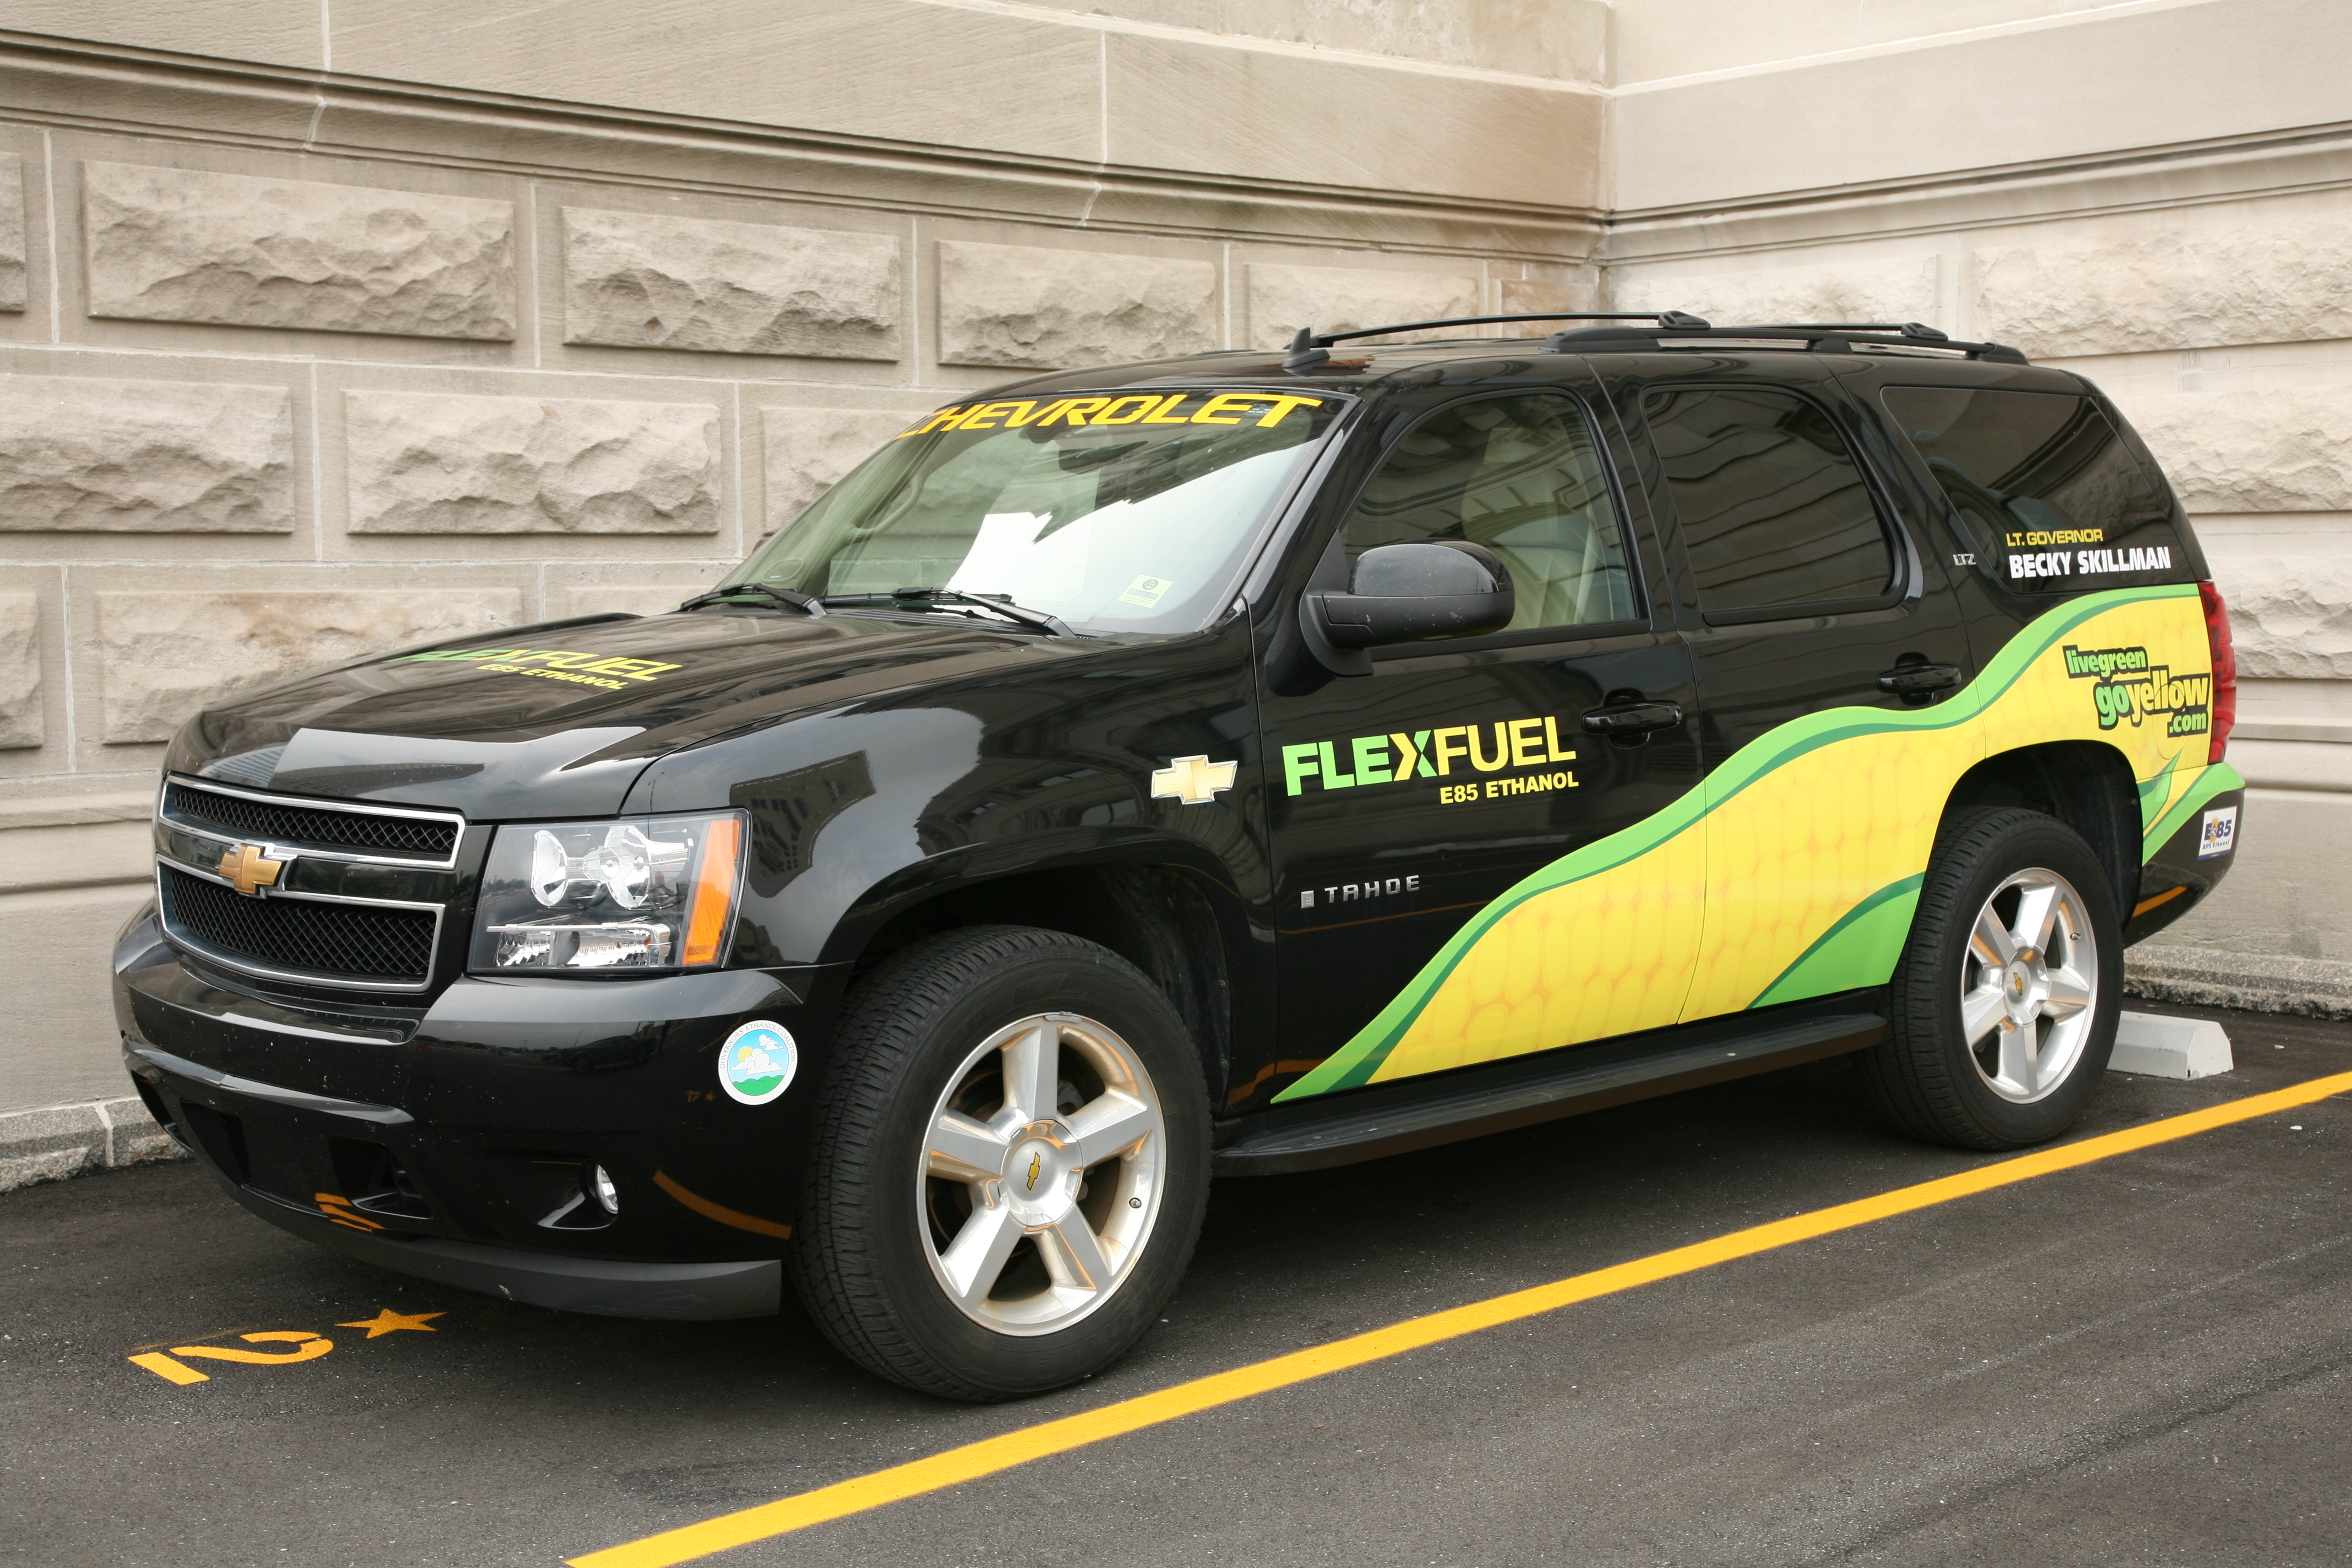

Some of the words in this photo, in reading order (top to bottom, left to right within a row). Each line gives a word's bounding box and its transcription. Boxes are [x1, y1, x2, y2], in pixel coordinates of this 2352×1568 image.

[2026, 528, 2103, 545] GOVERNOR
[1953, 554, 1976, 565] LTZ
[2009, 551, 2071, 578] BECKY
[2079, 547, 2171, 574] SKILLMAN
[476, 663, 527, 673] E85
[520, 668, 629, 690] ETHANOL
[2066, 649, 2146, 677] livegreen
[2095, 669, 2208, 726] goyellow
[2169, 712, 2206, 733] .com
[1282, 716, 1576, 796] FLEXFUEL
[1440, 783, 1479, 804] E85
[1486, 771, 1579, 799] ETHANOL
[1324, 874, 1419, 903] TAHOE
[746, 1022, 776, 1031] ETHANOL
[777, 1028, 796, 1062] COALITION
